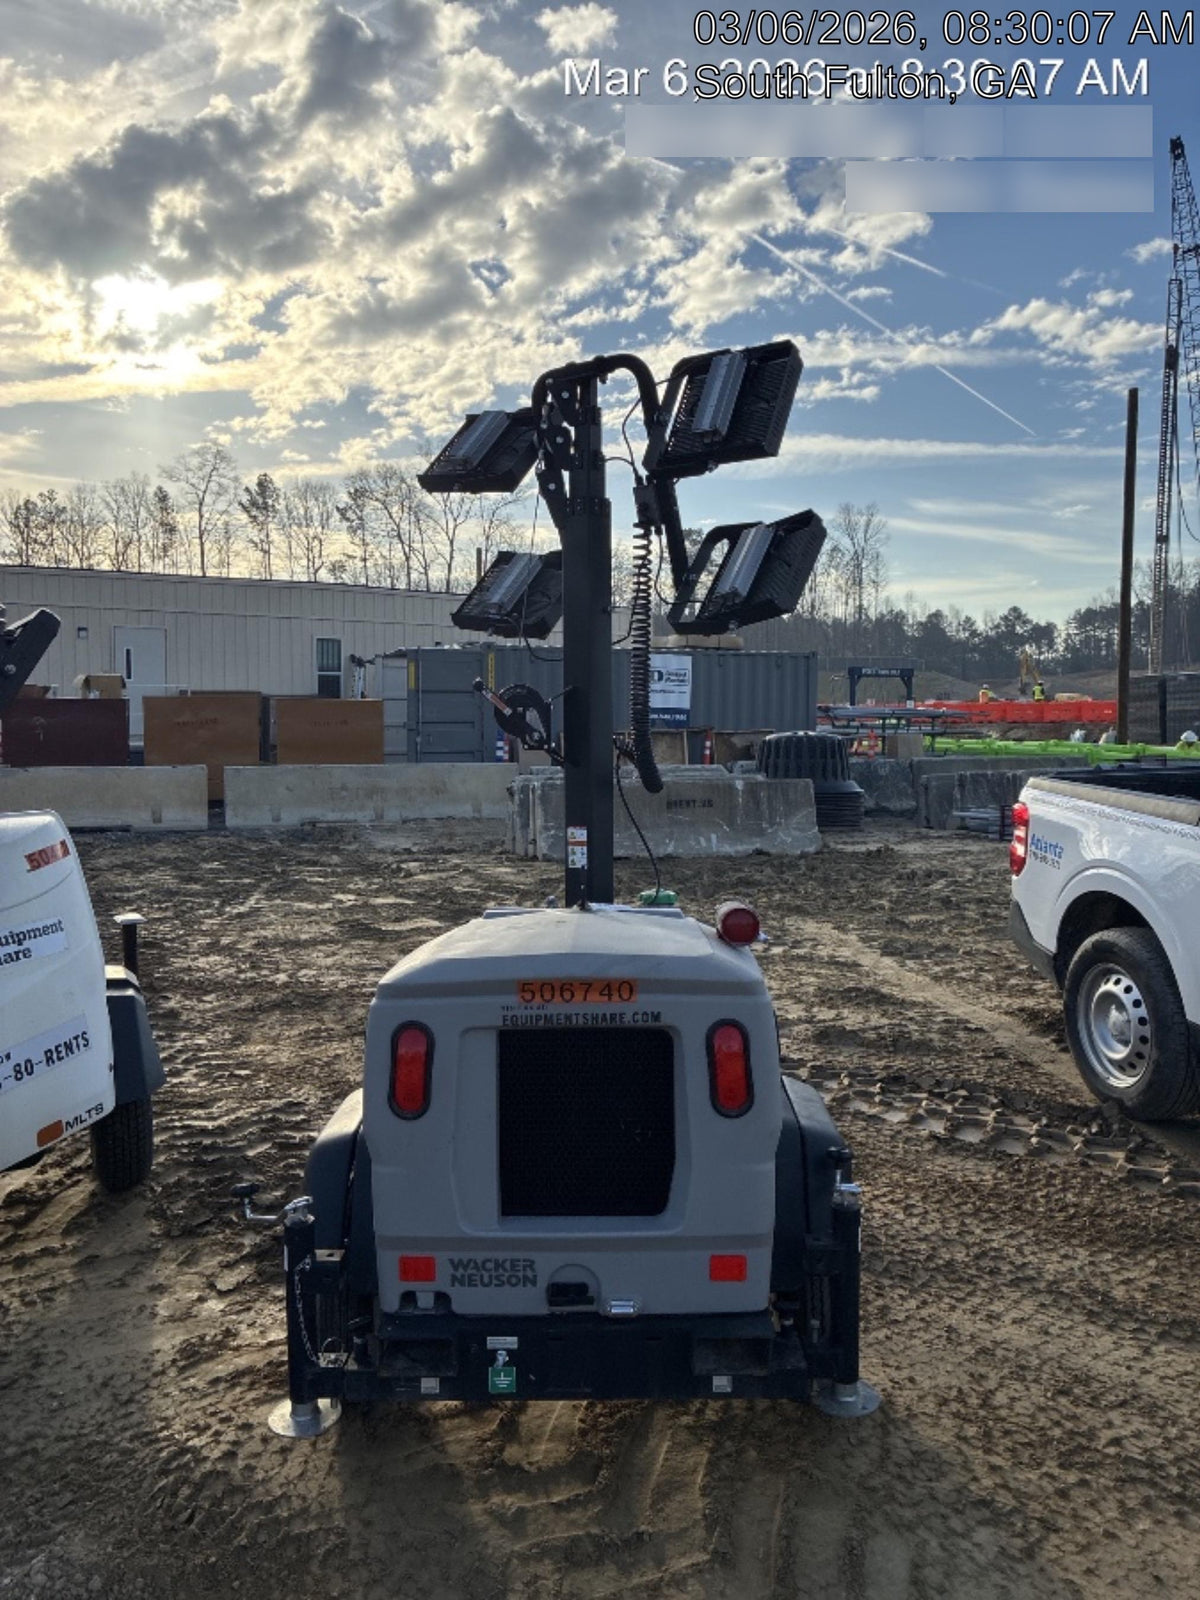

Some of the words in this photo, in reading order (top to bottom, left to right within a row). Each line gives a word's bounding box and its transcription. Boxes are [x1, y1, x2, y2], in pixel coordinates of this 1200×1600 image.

[520, 980, 634, 1004] 506740
[502, 1010, 662, 1027] EQUIPMENTSHARE.COM
[65, 1102, 104, 1132] MLTS
[447, 1258, 537, 1273] WACKER
[450, 1273, 538, 1288] NEUSON
